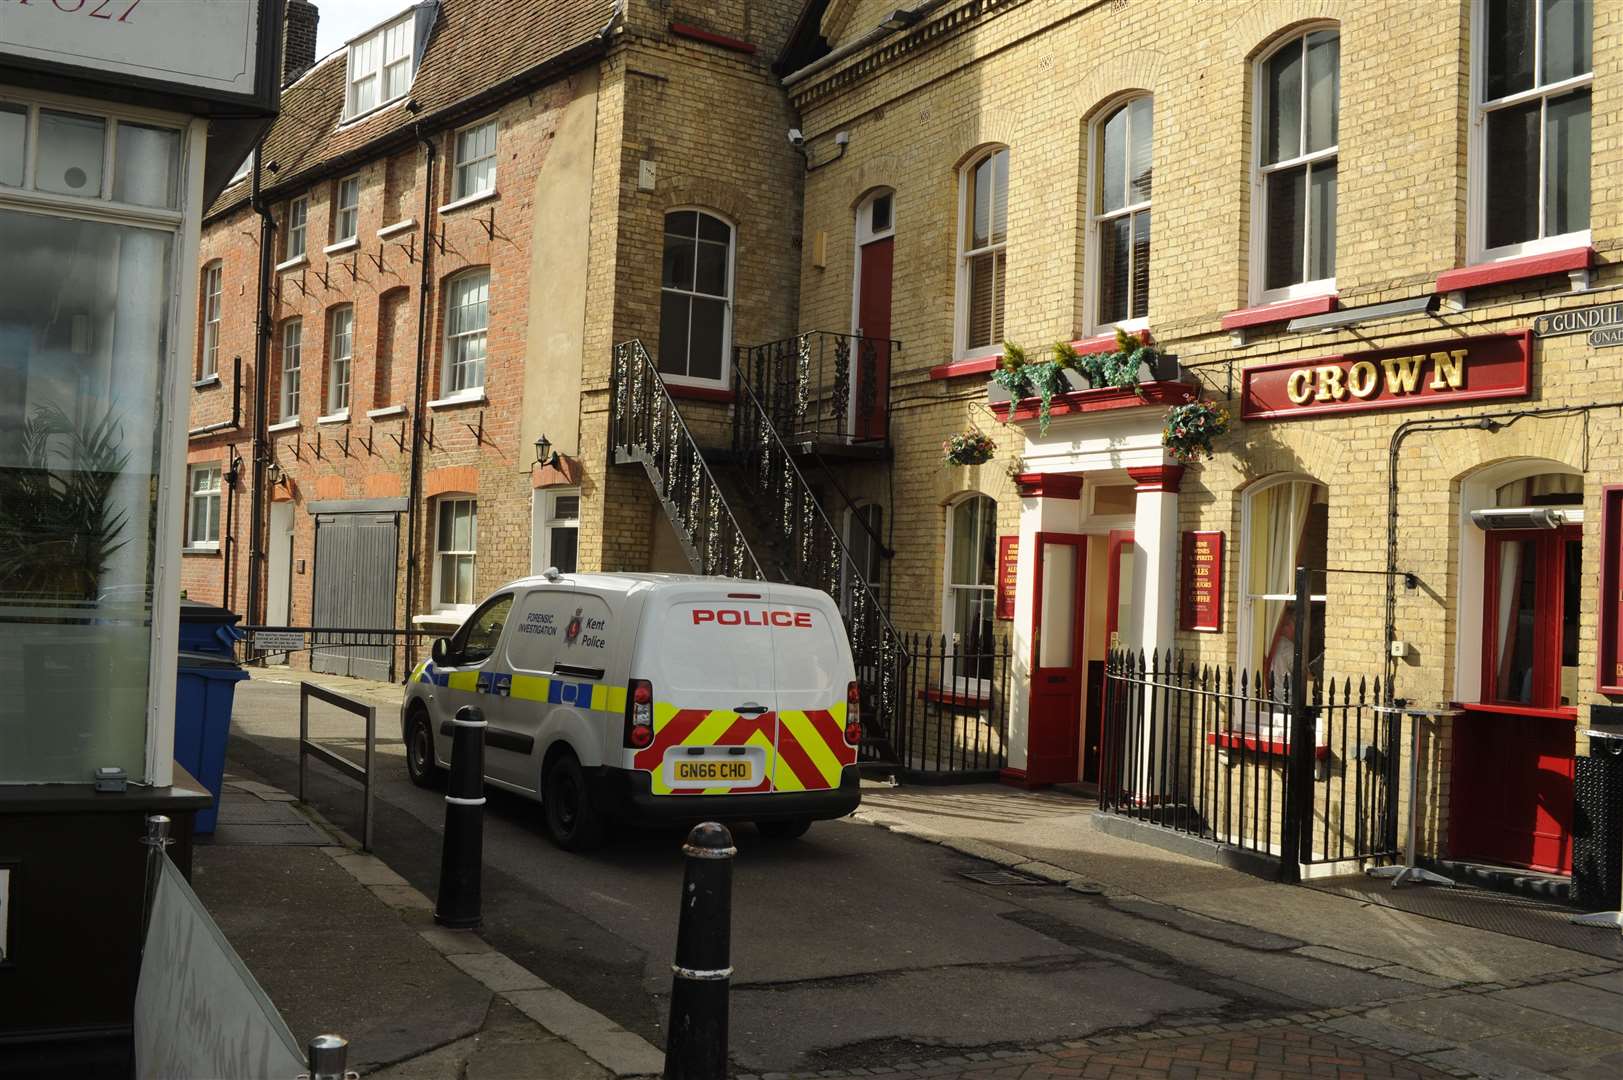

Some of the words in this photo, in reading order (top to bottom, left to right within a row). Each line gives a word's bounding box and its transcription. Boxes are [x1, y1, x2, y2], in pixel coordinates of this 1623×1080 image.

[1287, 349, 1468, 404] CROWN
[1193, 568, 1209, 576] ALES
[527, 612, 554, 624] FORENSIC
[586, 617, 605, 631] Kent
[692, 609, 813, 628] POLICE
[518, 624, 558, 636] INVESTIGATION
[581, 634, 606, 649] Police
[680, 763, 717, 778] GN66
[720, 763, 746, 778] CHO
